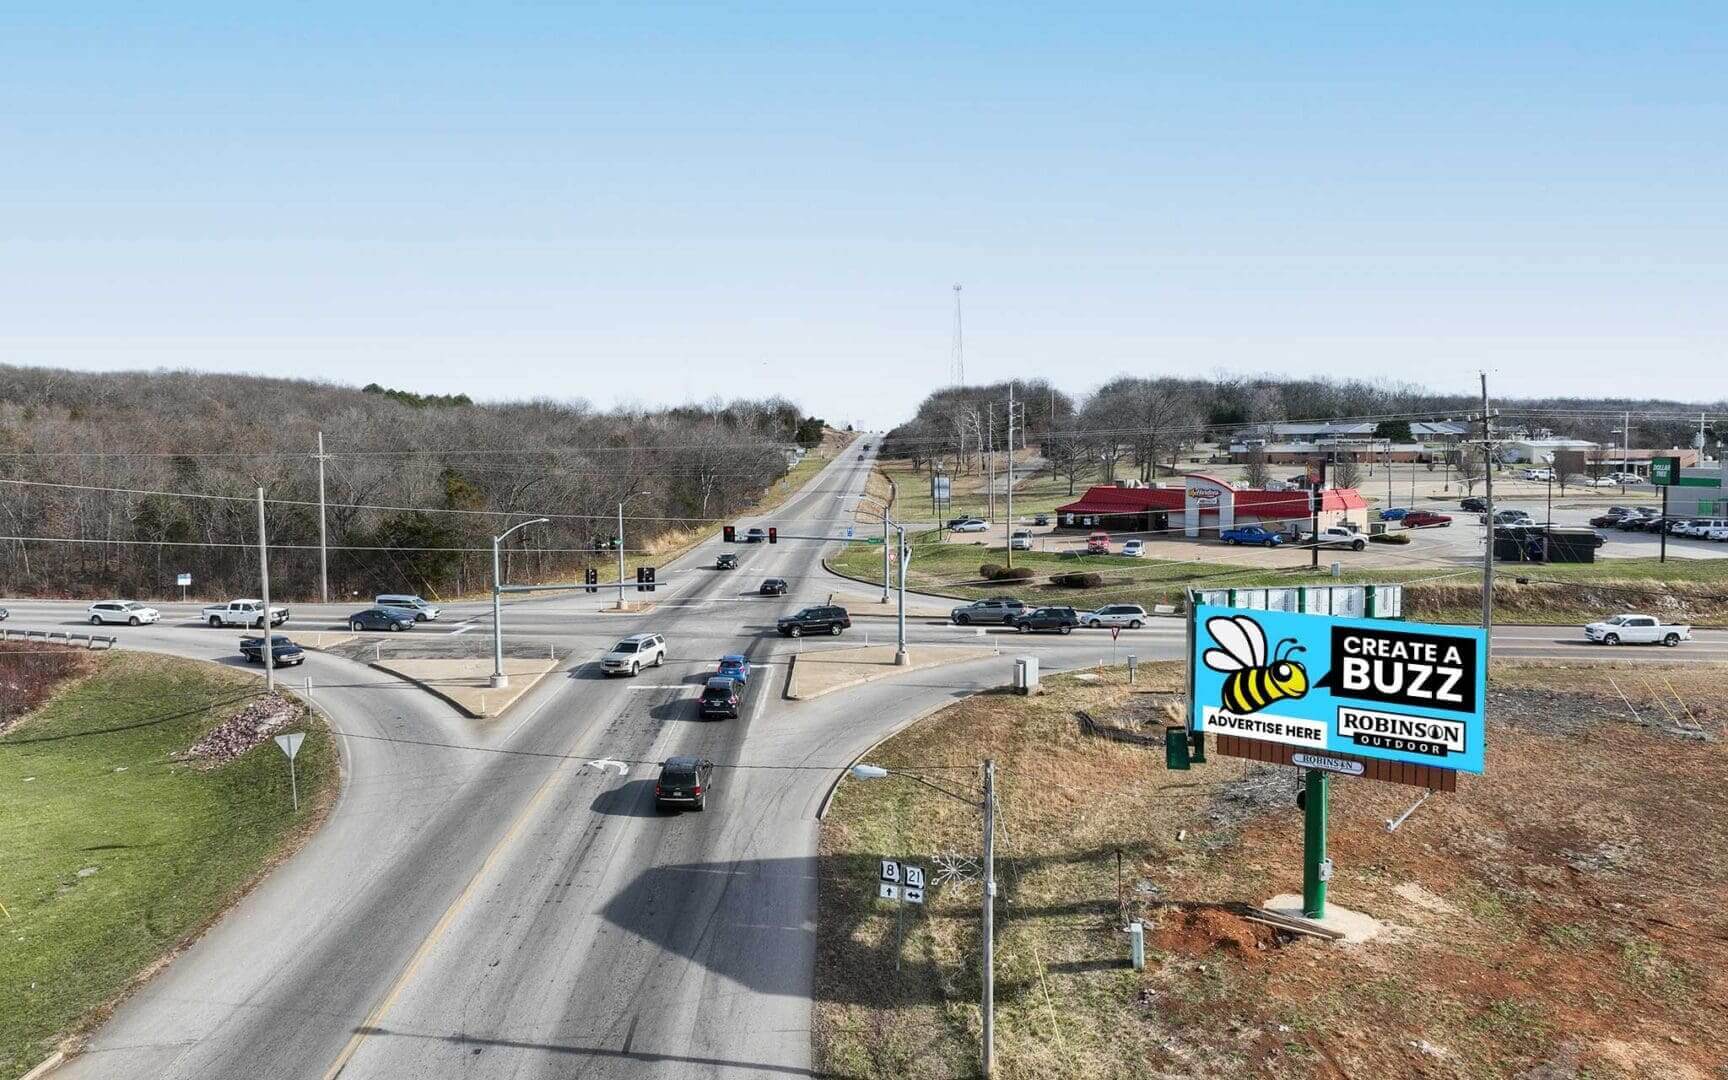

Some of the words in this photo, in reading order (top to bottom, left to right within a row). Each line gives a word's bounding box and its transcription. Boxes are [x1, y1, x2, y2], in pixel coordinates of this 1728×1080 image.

[1344, 636, 1438, 662] CREATE
[1442, 646, 1462, 665] A
[1343, 656, 1464, 702] BUZZ
[1208, 714, 1282, 735] ADVERTISE
[1286, 725, 1322, 740] HERE
[1344, 713, 1460, 742] ROBINSON
[1360, 736, 1440, 754] OUTDOOR
[886, 864, 894, 876] 8
[909, 870, 920, 883] 21
